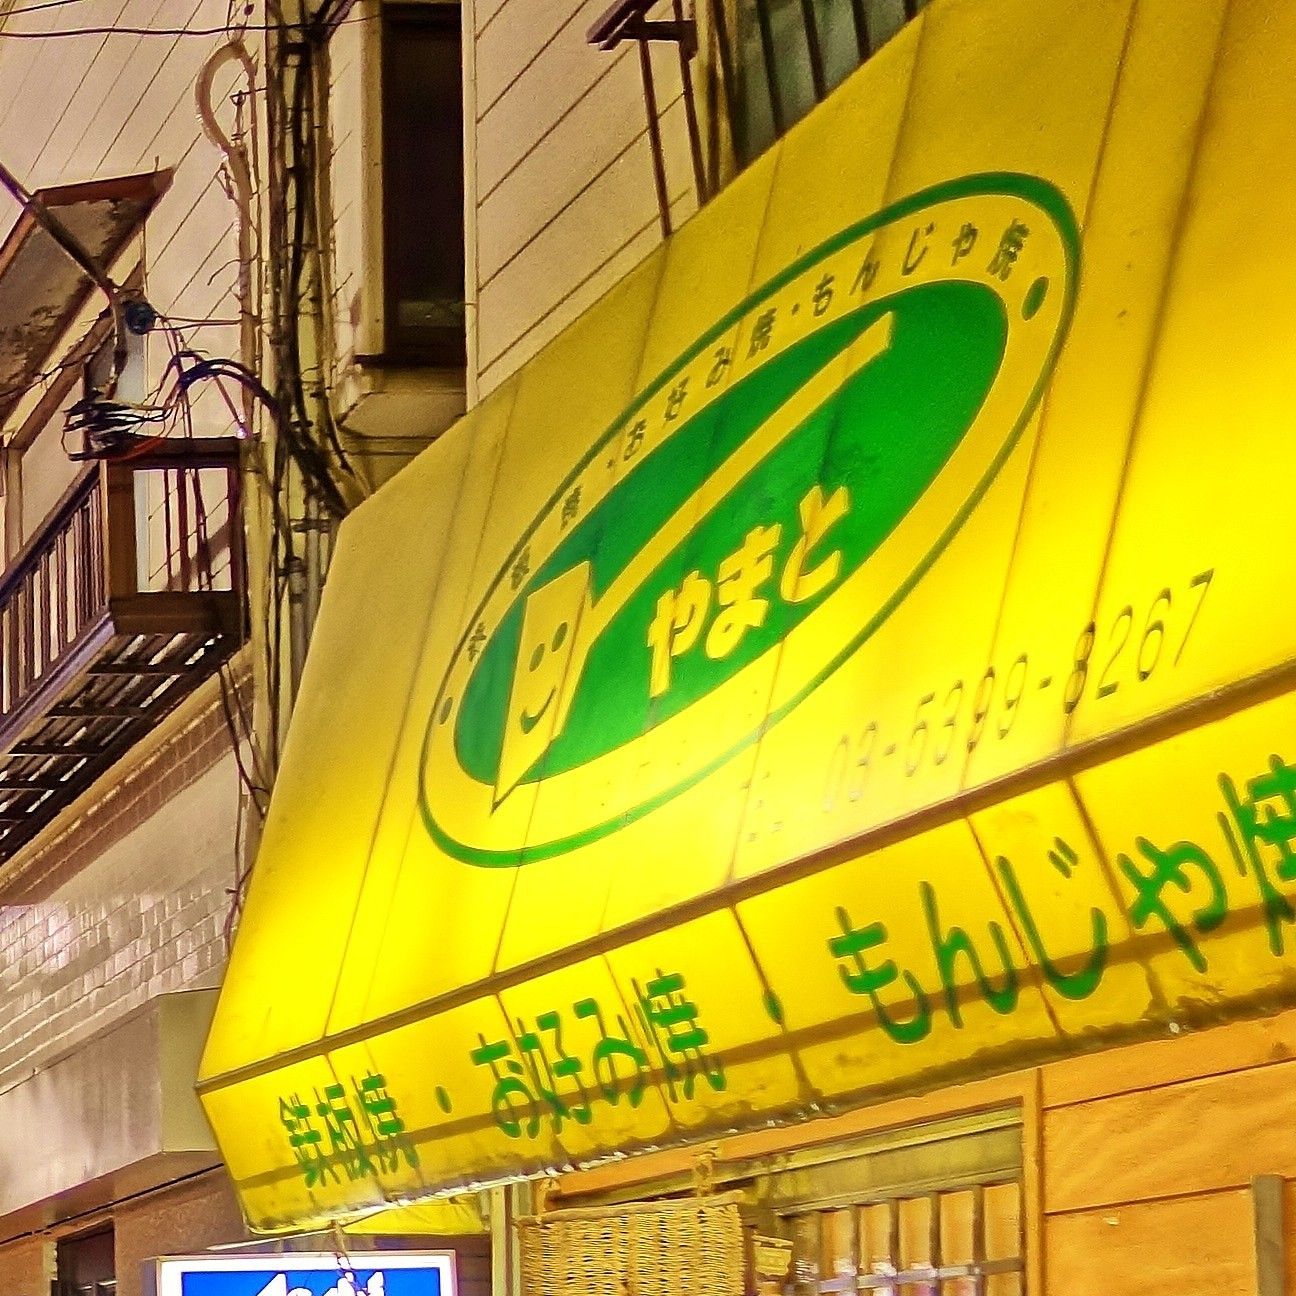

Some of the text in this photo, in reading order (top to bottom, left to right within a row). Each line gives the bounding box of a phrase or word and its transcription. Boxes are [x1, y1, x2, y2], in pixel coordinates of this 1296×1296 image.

[646, 484, 852, 698] やまと
[821, 567, 1216, 814] 03-5399-8267
